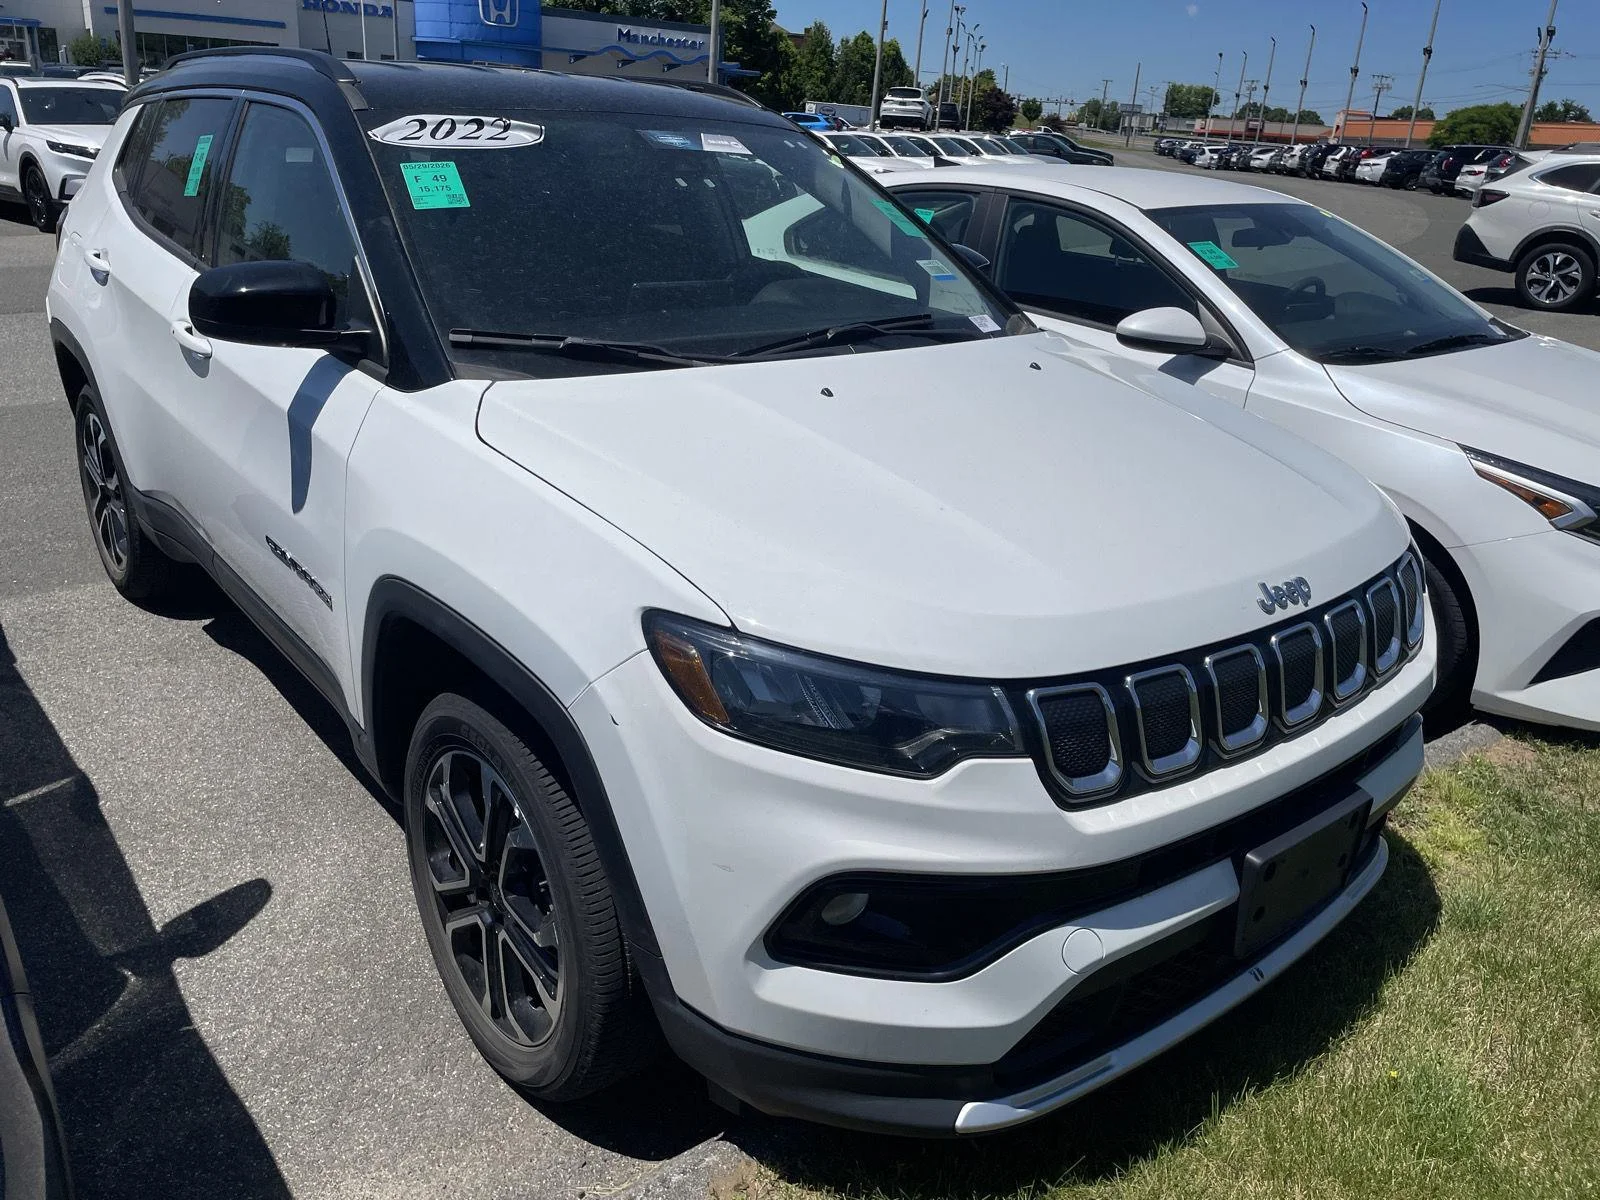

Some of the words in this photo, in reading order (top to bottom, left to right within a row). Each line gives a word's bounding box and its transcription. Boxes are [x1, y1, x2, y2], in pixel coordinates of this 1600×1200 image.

[302, 0, 394, 18] HONDA
[617, 27, 704, 50] Manchester
[399, 117, 512, 141] 2022
[414, 175, 421, 183] F
[432, 174, 448, 183] 49
[1257, 576, 1311, 616] Jeep
